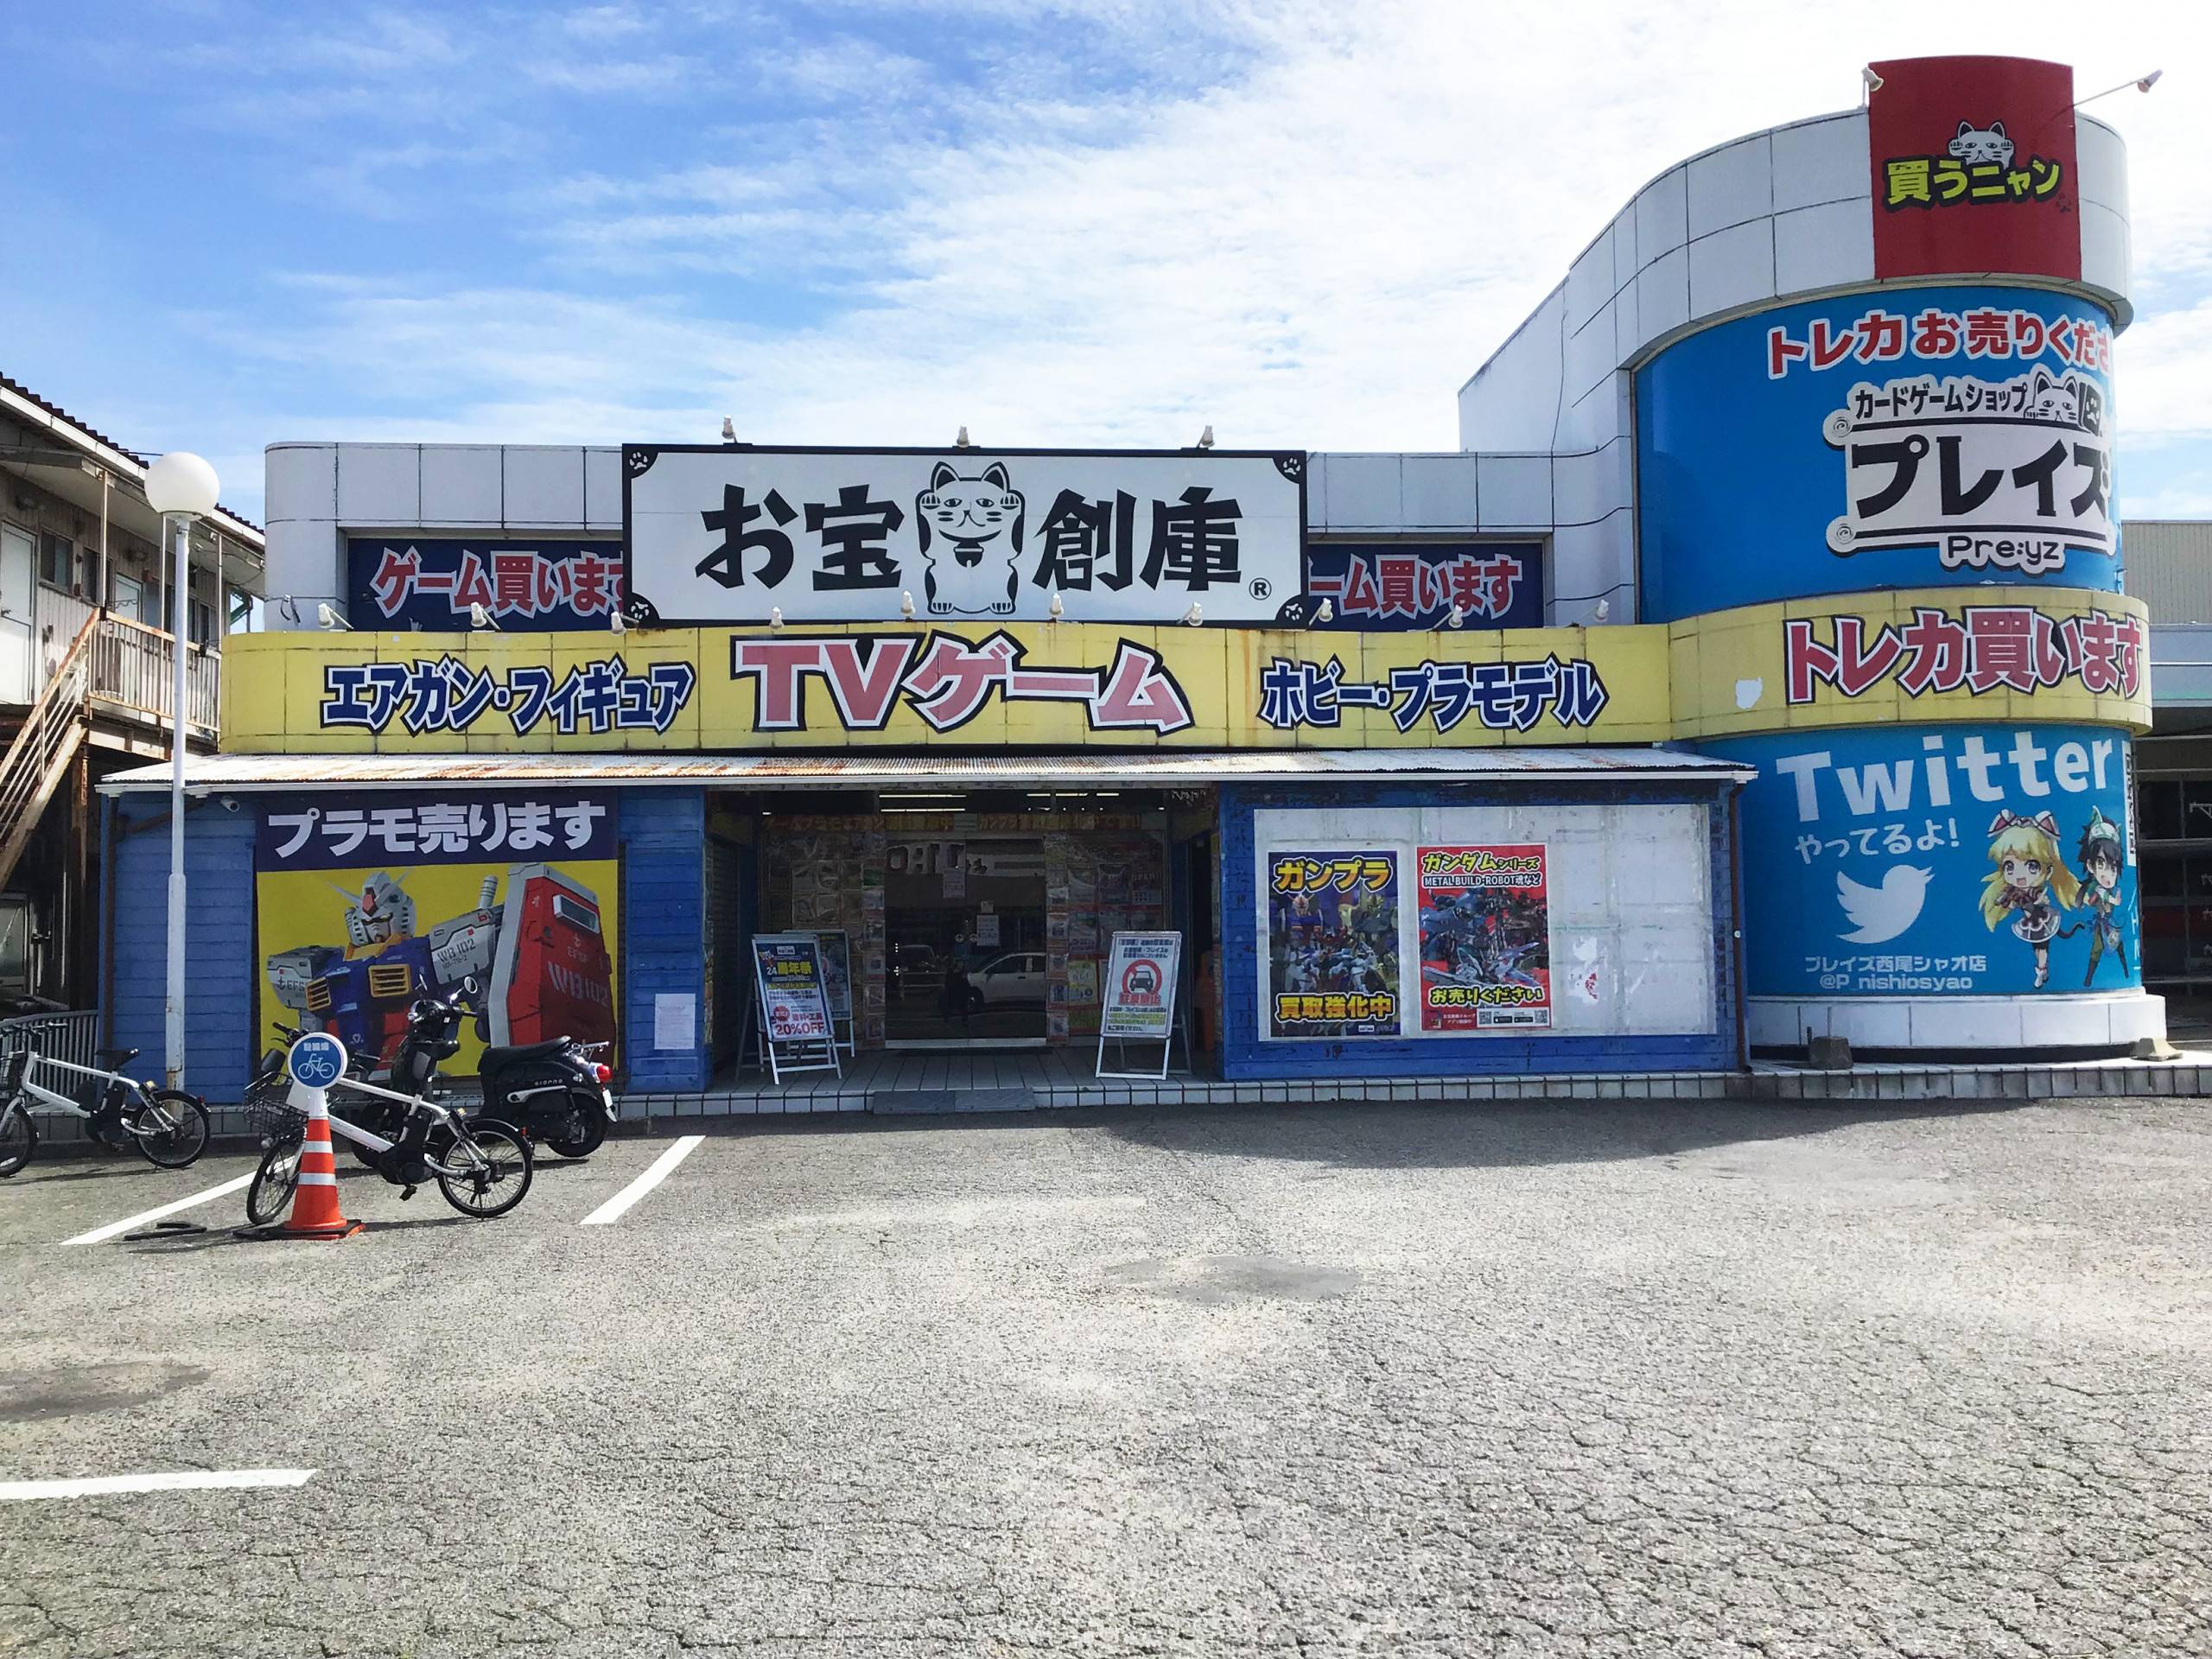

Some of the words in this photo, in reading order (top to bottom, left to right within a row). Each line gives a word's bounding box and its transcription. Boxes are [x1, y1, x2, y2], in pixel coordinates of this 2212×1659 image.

[1885, 157, 2063, 207] 買うニャン
[1855, 381, 2028, 420] カードゲームショップ
[1308, 553, 1523, 620] ーム買います
[1784, 606, 2143, 705] トレカ買います
[731, 628, 1195, 737] TVゲーム
[1257, 652, 1611, 735] ホビー・プラモデル
[1776, 731, 2113, 823] Twitter
[268, 800, 606, 858] プラモ売ります
[1273, 855, 1393, 893] ガンプラ
[1423, 852, 1541, 873] ガンダムシリーズ
[1277, 990, 1395, 1022] 買取強化中
[1430, 986, 1544, 1005] お売りください
[775, 1022, 825, 1035] 20%OFF
